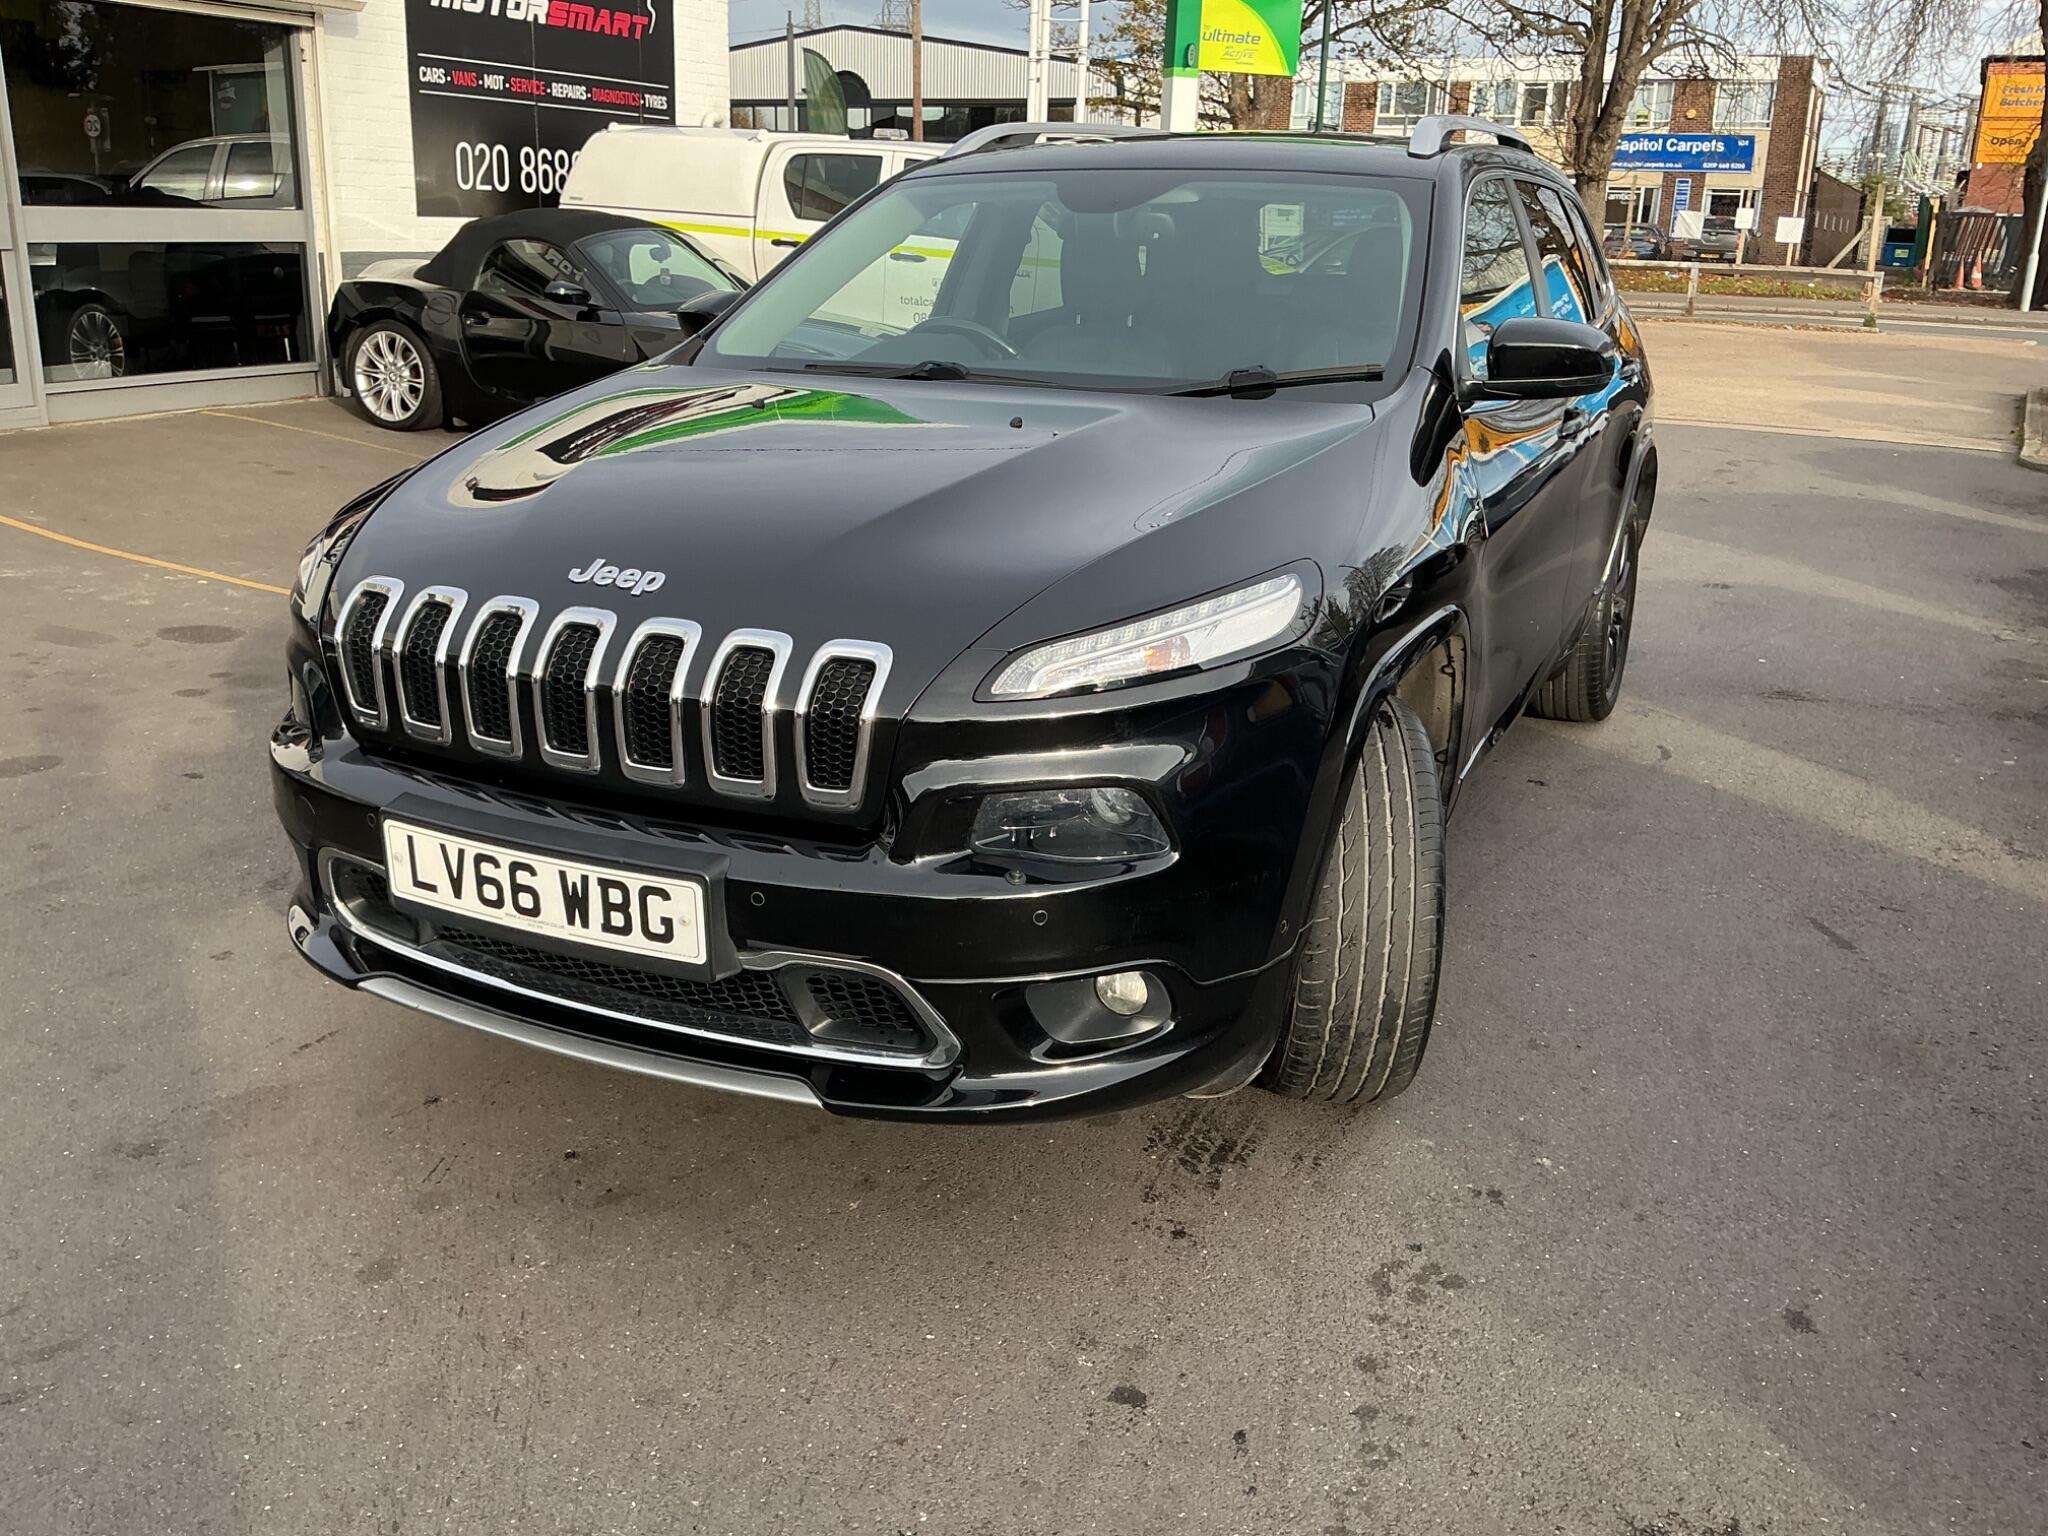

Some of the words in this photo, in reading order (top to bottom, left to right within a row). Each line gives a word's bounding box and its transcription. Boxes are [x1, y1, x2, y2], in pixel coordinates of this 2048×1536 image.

[419, 66, 446, 83] CARS
[452, 70, 478, 88] VANS
[483, 77, 504, 91] MOT
[510, 77, 546, 96] SERVICE
[551, 83, 587, 100] REPAIRS
[591, 88, 641, 107] DIAGNOSTICS
[644, 93, 668, 110] TYRES
[455, 141, 510, 192] 020
[520, 146, 582, 194] 868
[1666, 138, 1725, 155] Carpets
[568, 558, 666, 596] Jeep
[406, 834, 542, 919] LV66
[558, 869, 674, 944] WBG
